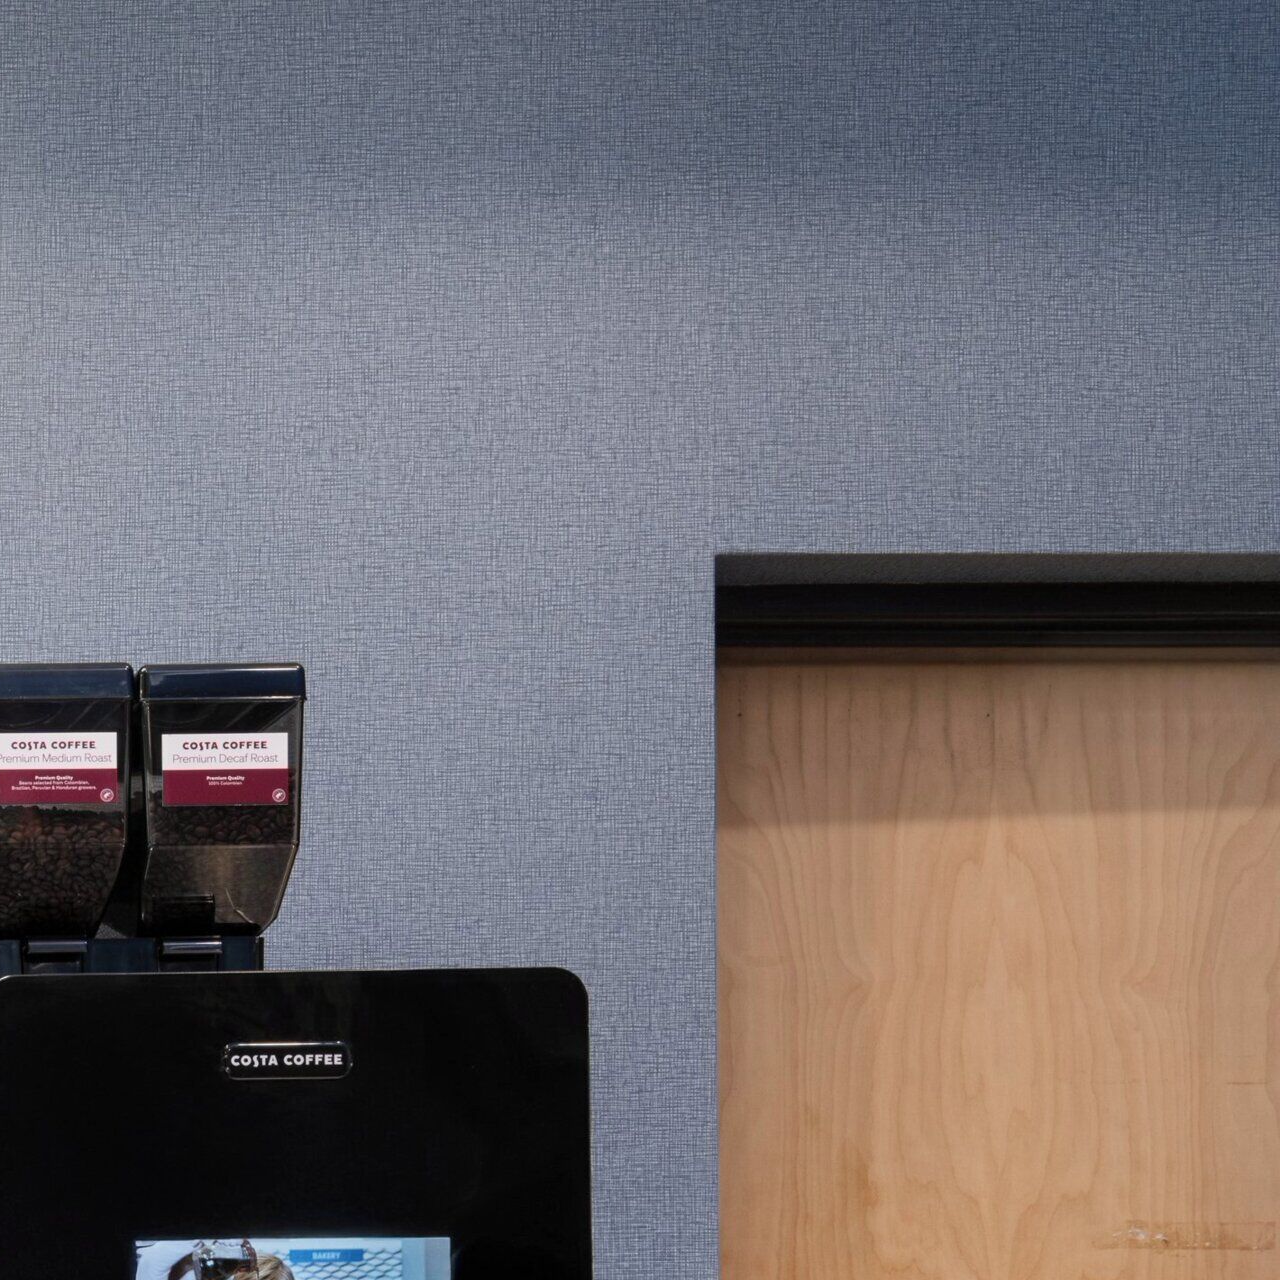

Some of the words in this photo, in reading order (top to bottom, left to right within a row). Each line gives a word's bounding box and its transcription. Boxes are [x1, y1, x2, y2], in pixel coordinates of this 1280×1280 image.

[11, 741, 46, 750] COSTA
[51, 741, 96, 749] COFFEE
[182, 741, 218, 751] COSTA
[223, 741, 267, 749] COFFEE
[42, 753, 81, 763] Medium
[84, 752, 112, 762] Roast
[173, 754, 216, 764] Premium
[219, 753, 249, 763] Decaf
[251, 753, 279, 763] Roast
[230, 1054, 278, 1068] COSTA
[283, 1054, 343, 1066] COFFEE
[311, 1251, 341, 1260] BAKERY
